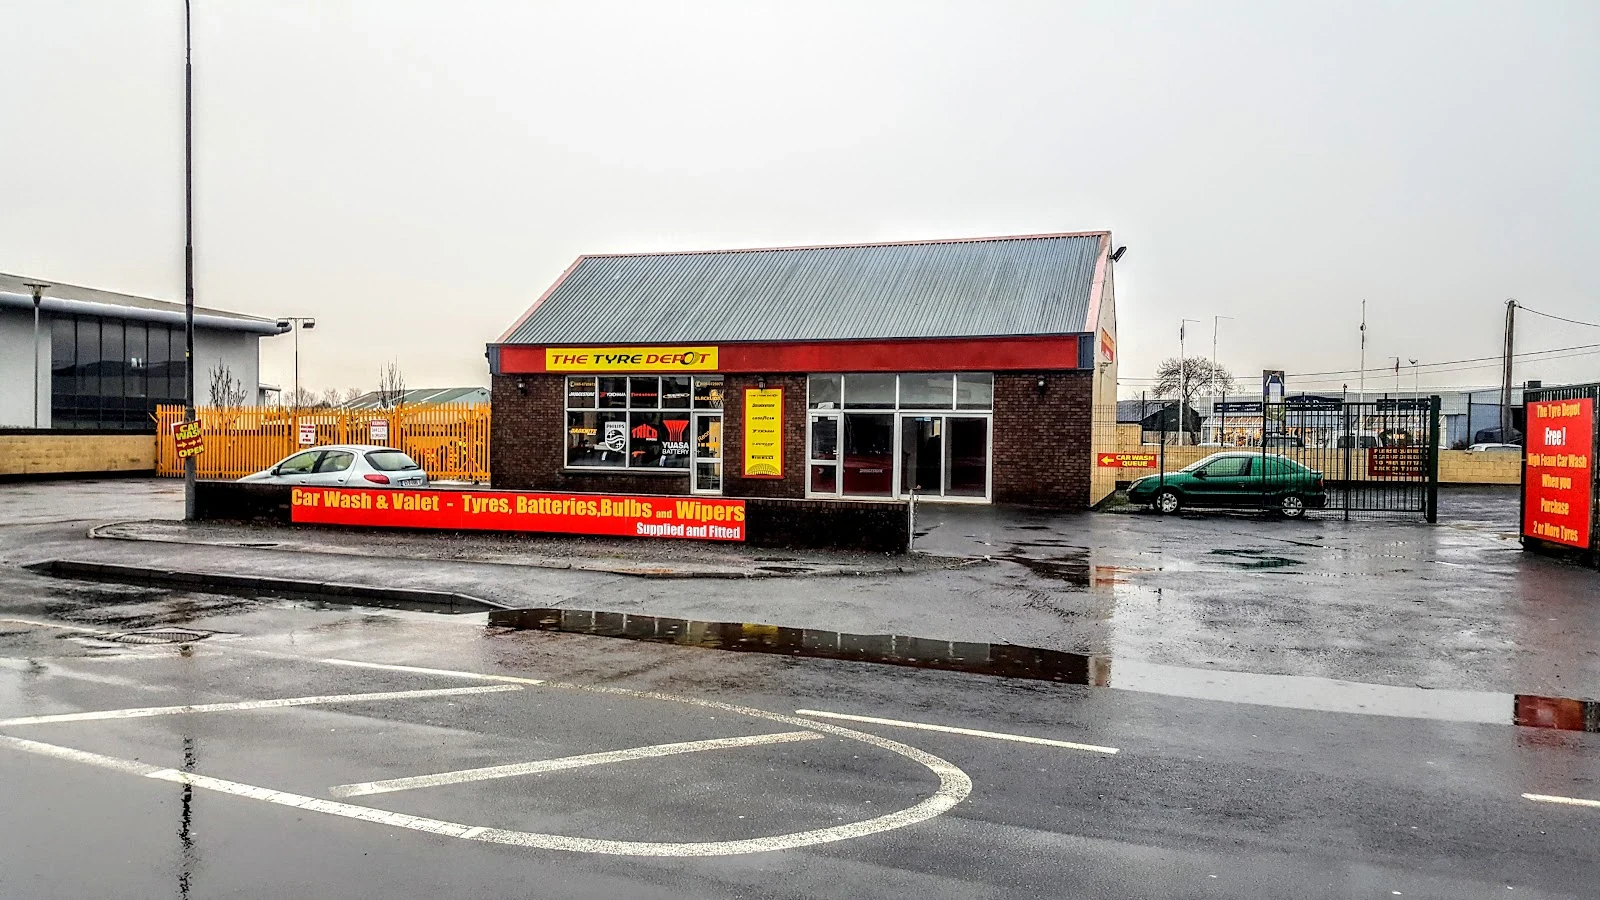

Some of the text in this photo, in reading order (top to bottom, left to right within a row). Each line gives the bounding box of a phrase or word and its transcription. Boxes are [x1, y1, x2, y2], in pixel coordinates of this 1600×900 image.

[552, 351, 710, 365] THE TYRE DEPOT
[1537, 402, 1580, 419] The Tyre Depot
[180, 422, 199, 432] CAR
[179, 445, 204, 457] OPEN
[662, 441, 689, 449] YUASA
[1541, 453, 1557, 467] Foam
[1557, 454, 1568, 467] Car
[1568, 454, 1587, 468] Wash
[291, 488, 320, 506] Car
[323, 490, 372, 509] Wash
[376, 494, 389, 510] &
[391, 493, 439, 511] Valet
[462, 494, 512, 514] Tyres,
[655, 510, 672, 519] and
[676, 501, 745, 522] Wipers
[1541, 498, 1569, 515] Purchase
[636, 521, 741, 539] Supplied and Fitted
[1533, 521, 1578, 542] 2 or More Tyres
